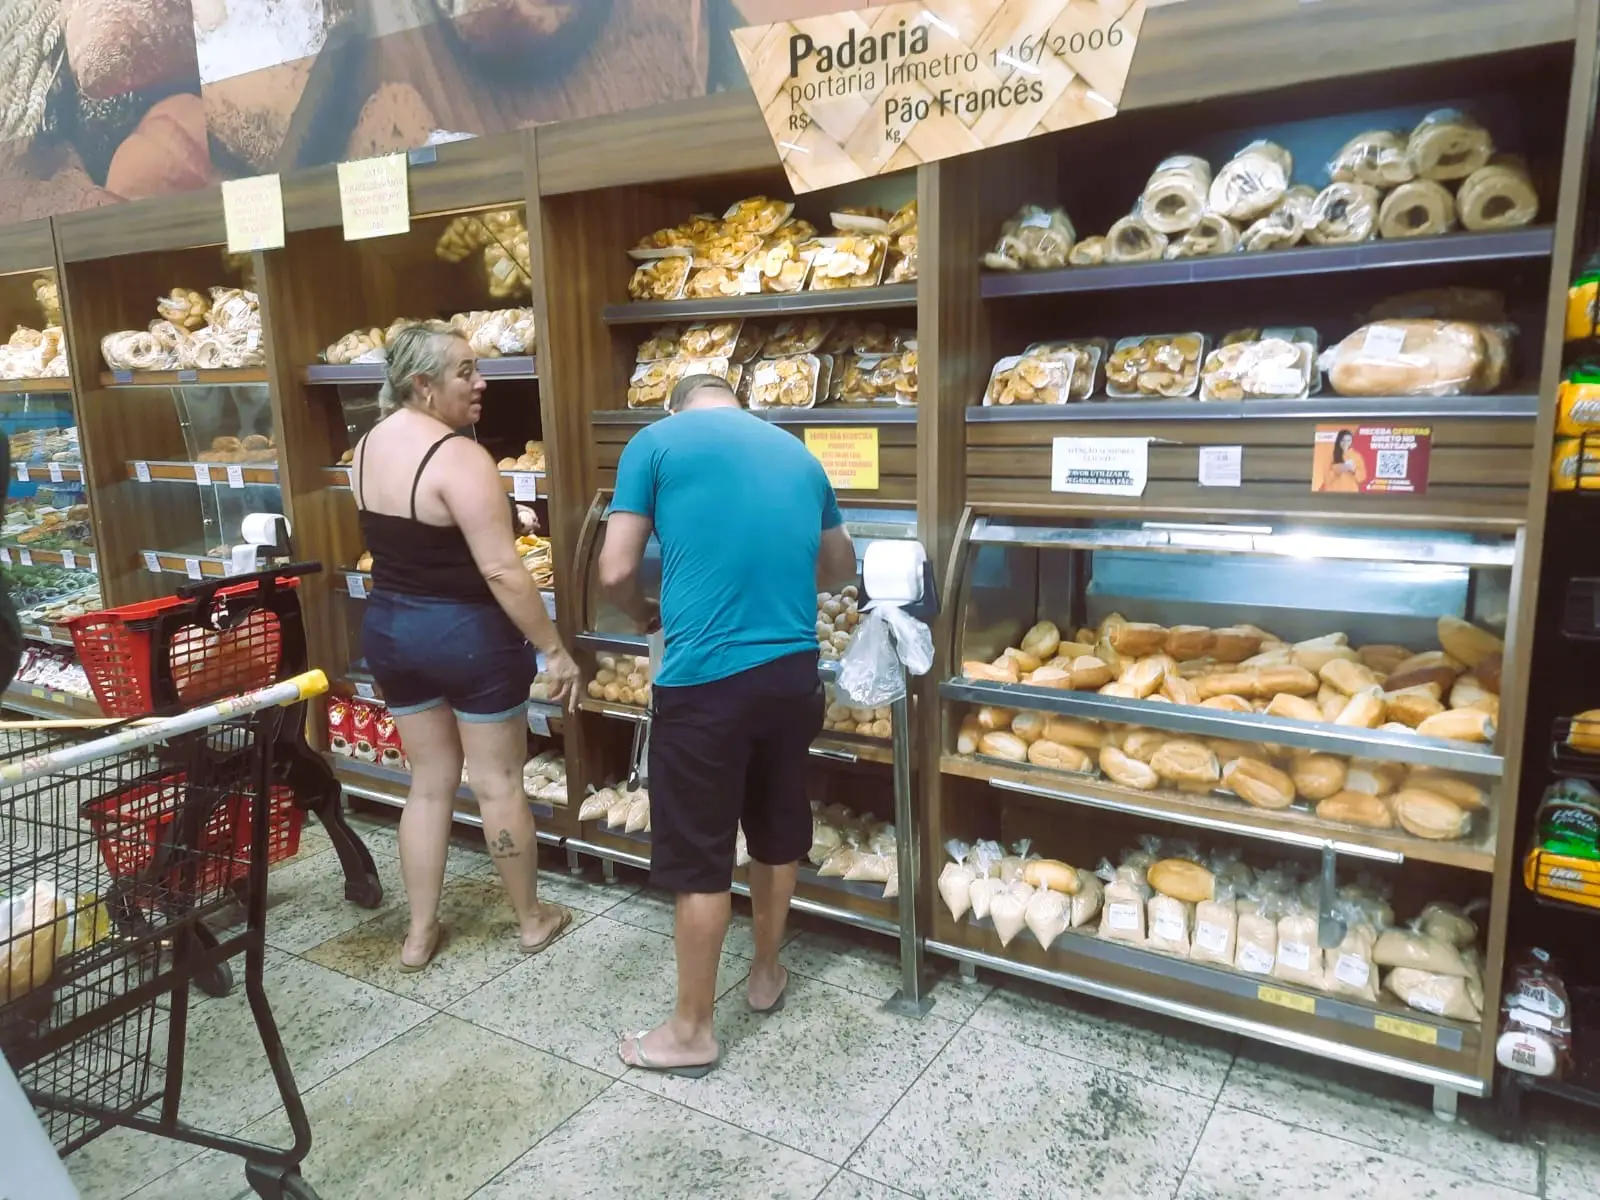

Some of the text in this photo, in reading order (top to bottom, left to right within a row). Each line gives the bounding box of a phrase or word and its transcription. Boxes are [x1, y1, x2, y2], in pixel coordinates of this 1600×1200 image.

[789, 20, 929, 78] Padaria
[790, 18, 1123, 111] portaria Inmetro 146/2006
[789, 111, 809, 131] R$
[885, 77, 1044, 126] Pão Francês
[885, 127, 902, 143] Kg
